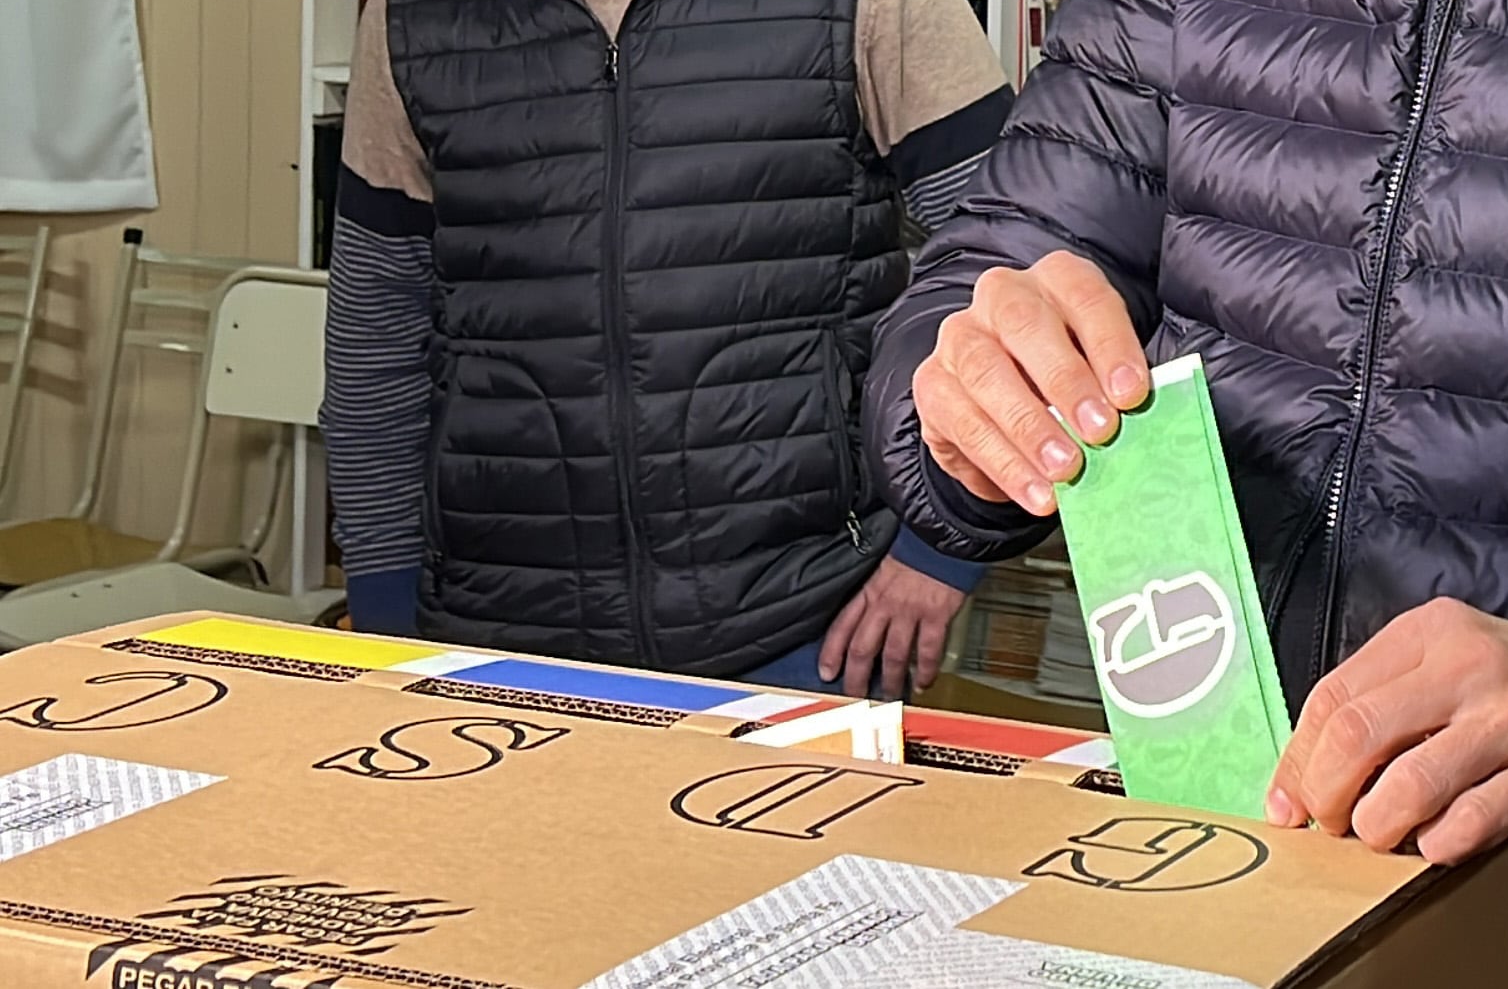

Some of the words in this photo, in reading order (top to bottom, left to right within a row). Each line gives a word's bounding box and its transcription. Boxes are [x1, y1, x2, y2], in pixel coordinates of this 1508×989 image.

[1088, 569, 1236, 719] G
[0, 670, 228, 732] C
[311, 716, 571, 781] S
[668, 763, 926, 841] D
[1021, 816, 1269, 892] G
[189, 908, 261, 927] FAJA
[225, 902, 368, 932] ADHESIVA
[226, 892, 402, 927] PROVISORIO
[254, 885, 410, 917] DEFINITIVO
[261, 920, 365, 945] PEGAR
